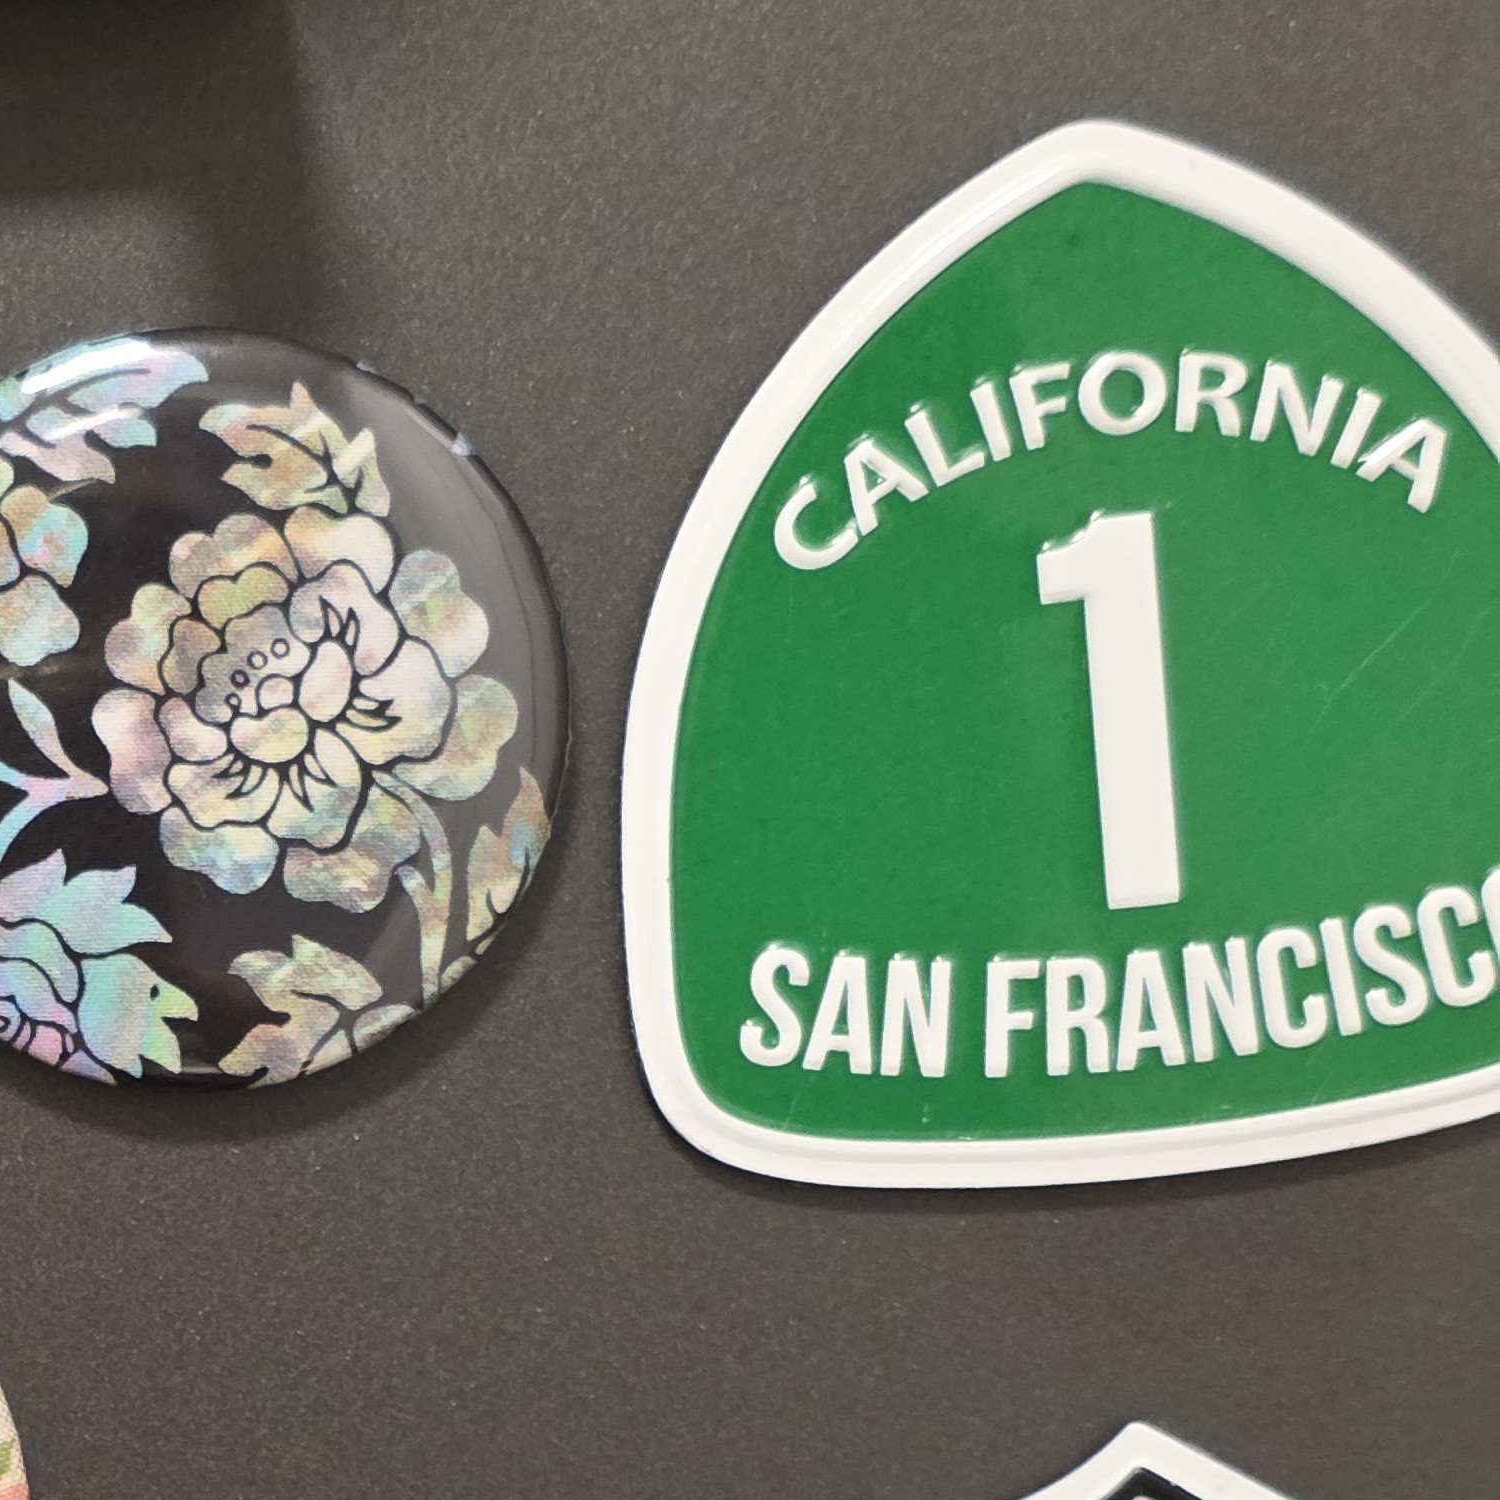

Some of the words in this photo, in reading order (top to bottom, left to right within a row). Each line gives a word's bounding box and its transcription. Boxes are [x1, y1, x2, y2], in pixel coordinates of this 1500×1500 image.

[772, 349, 1450, 571] CALIFORNIA
[1035, 510, 1181, 909] 1
[739, 942, 953, 1078] SAN
[984, 865, 1500, 1078] FRANCISC
